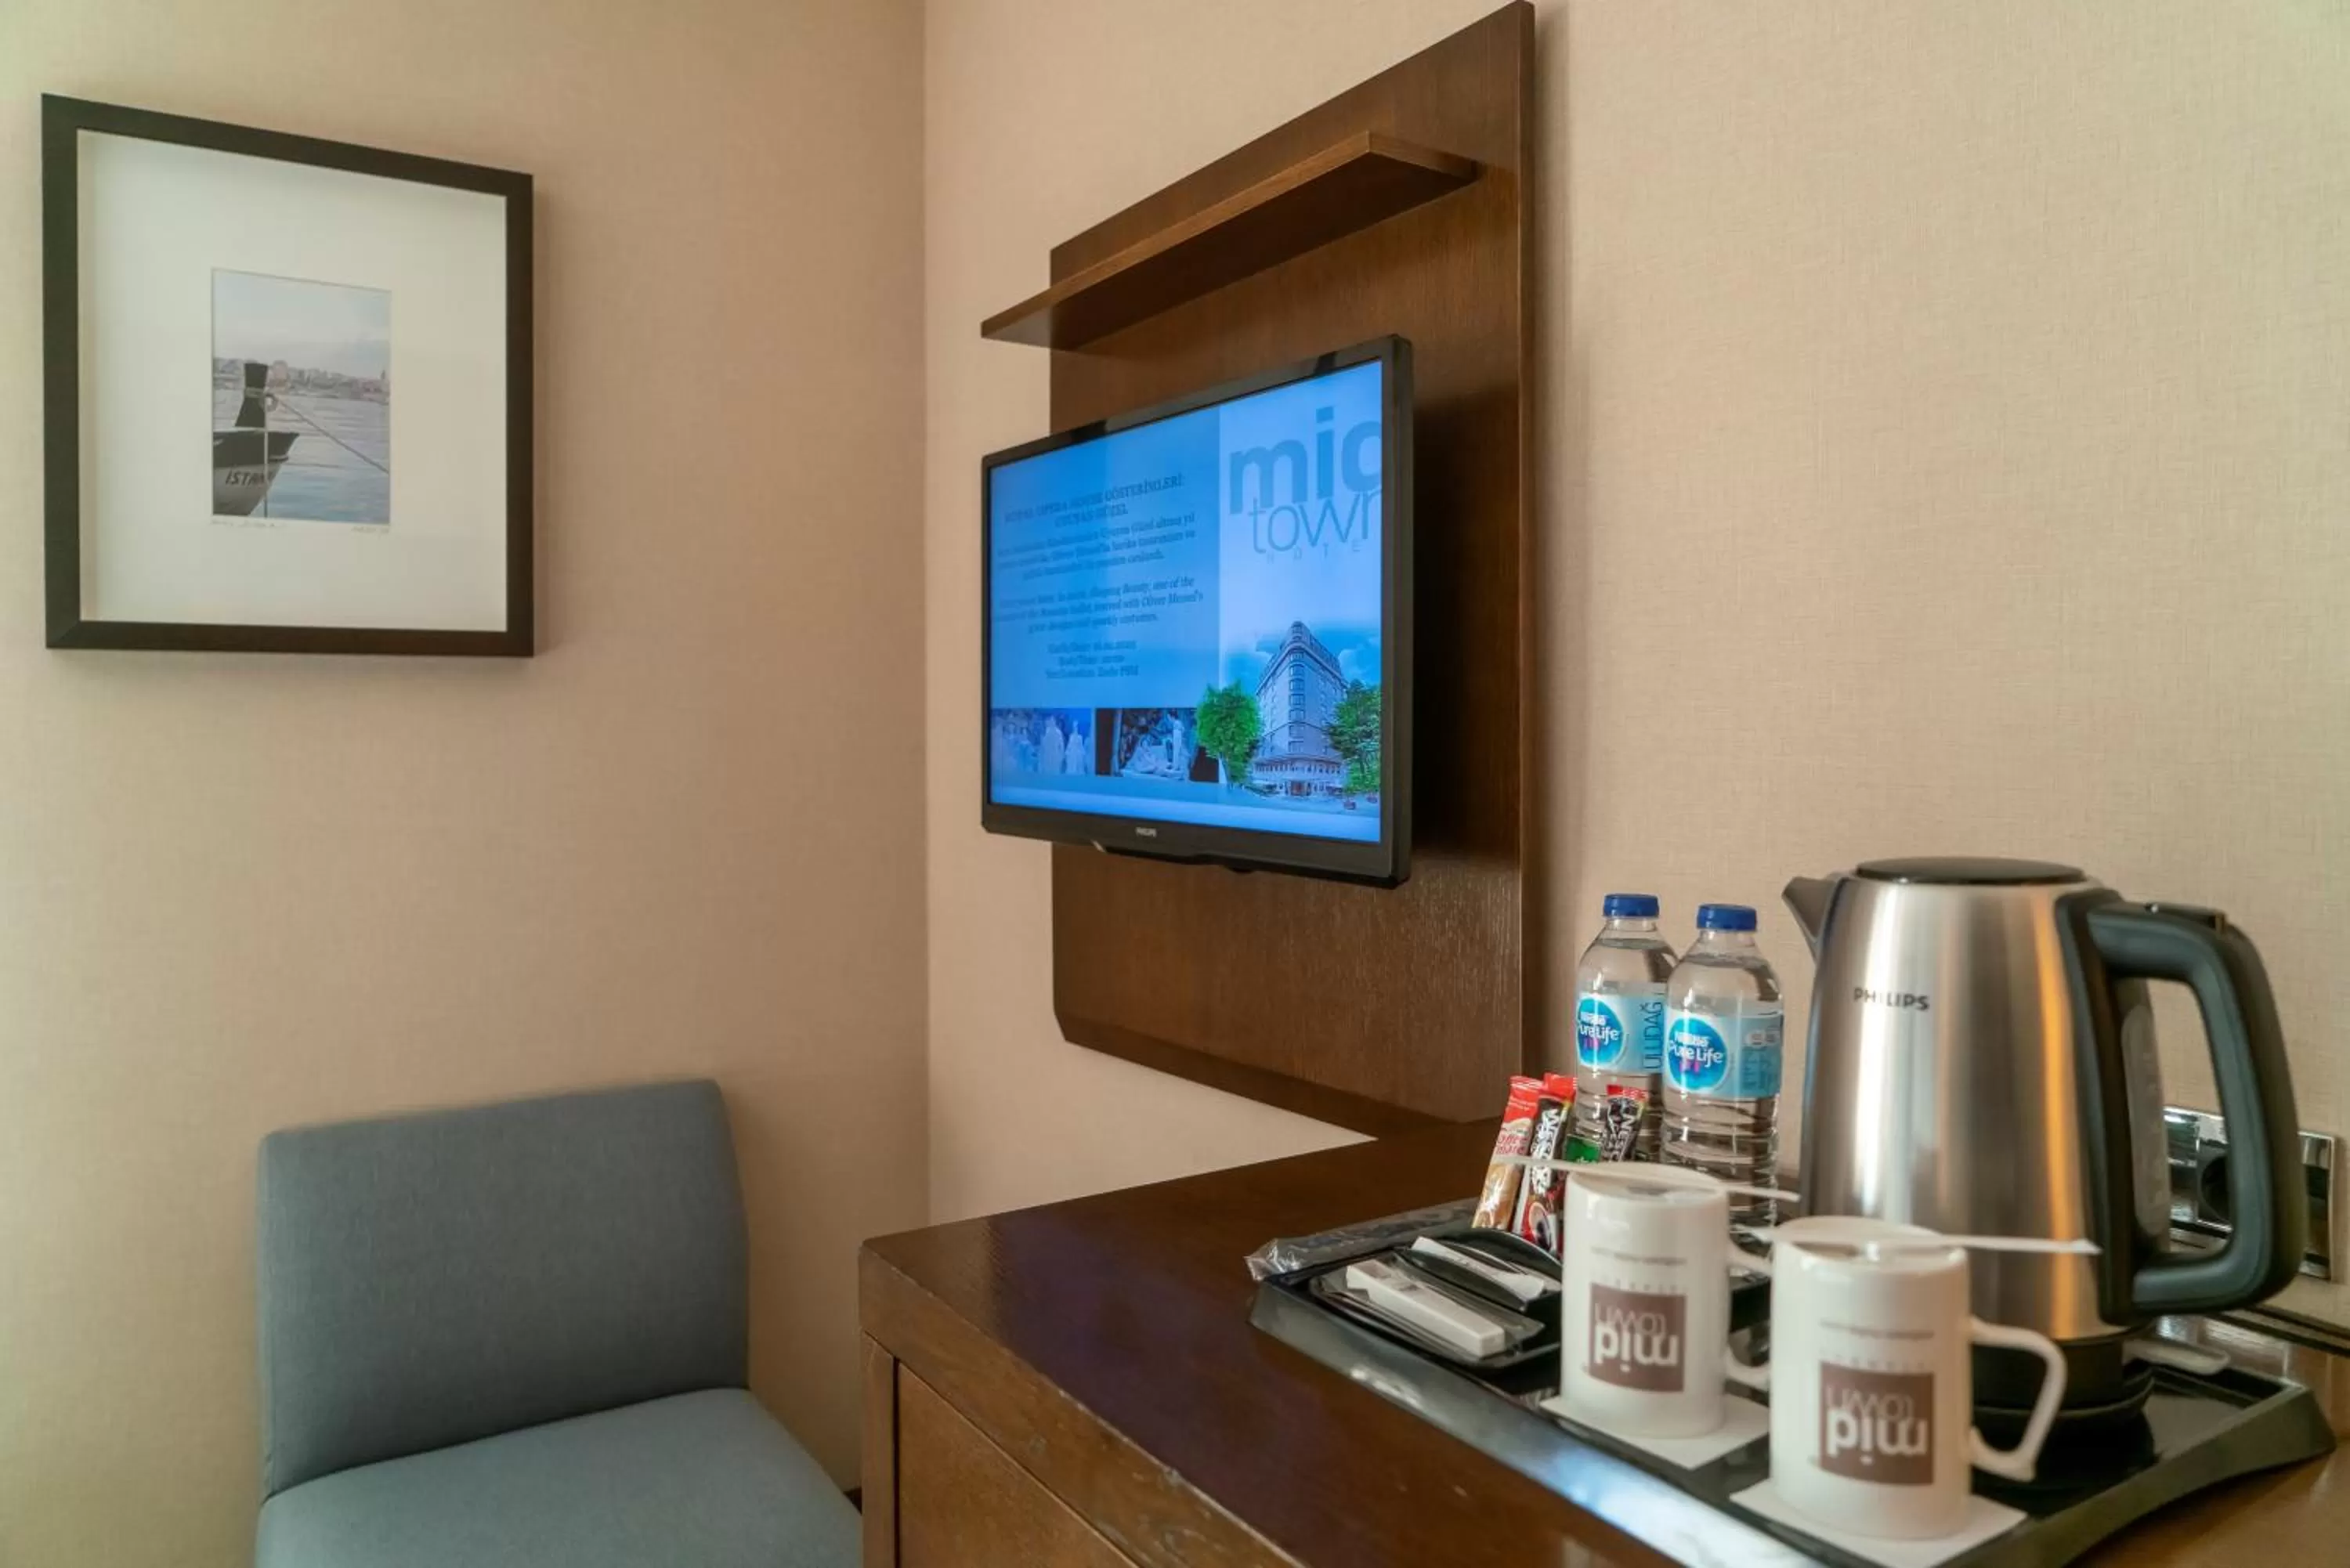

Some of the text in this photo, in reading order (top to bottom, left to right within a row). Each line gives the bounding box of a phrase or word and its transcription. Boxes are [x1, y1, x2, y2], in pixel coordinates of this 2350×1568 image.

[1696, 1047, 1724, 1068] Life
[1594, 1323, 1680, 1372] mid
[1826, 1407, 1929, 1465] mid
